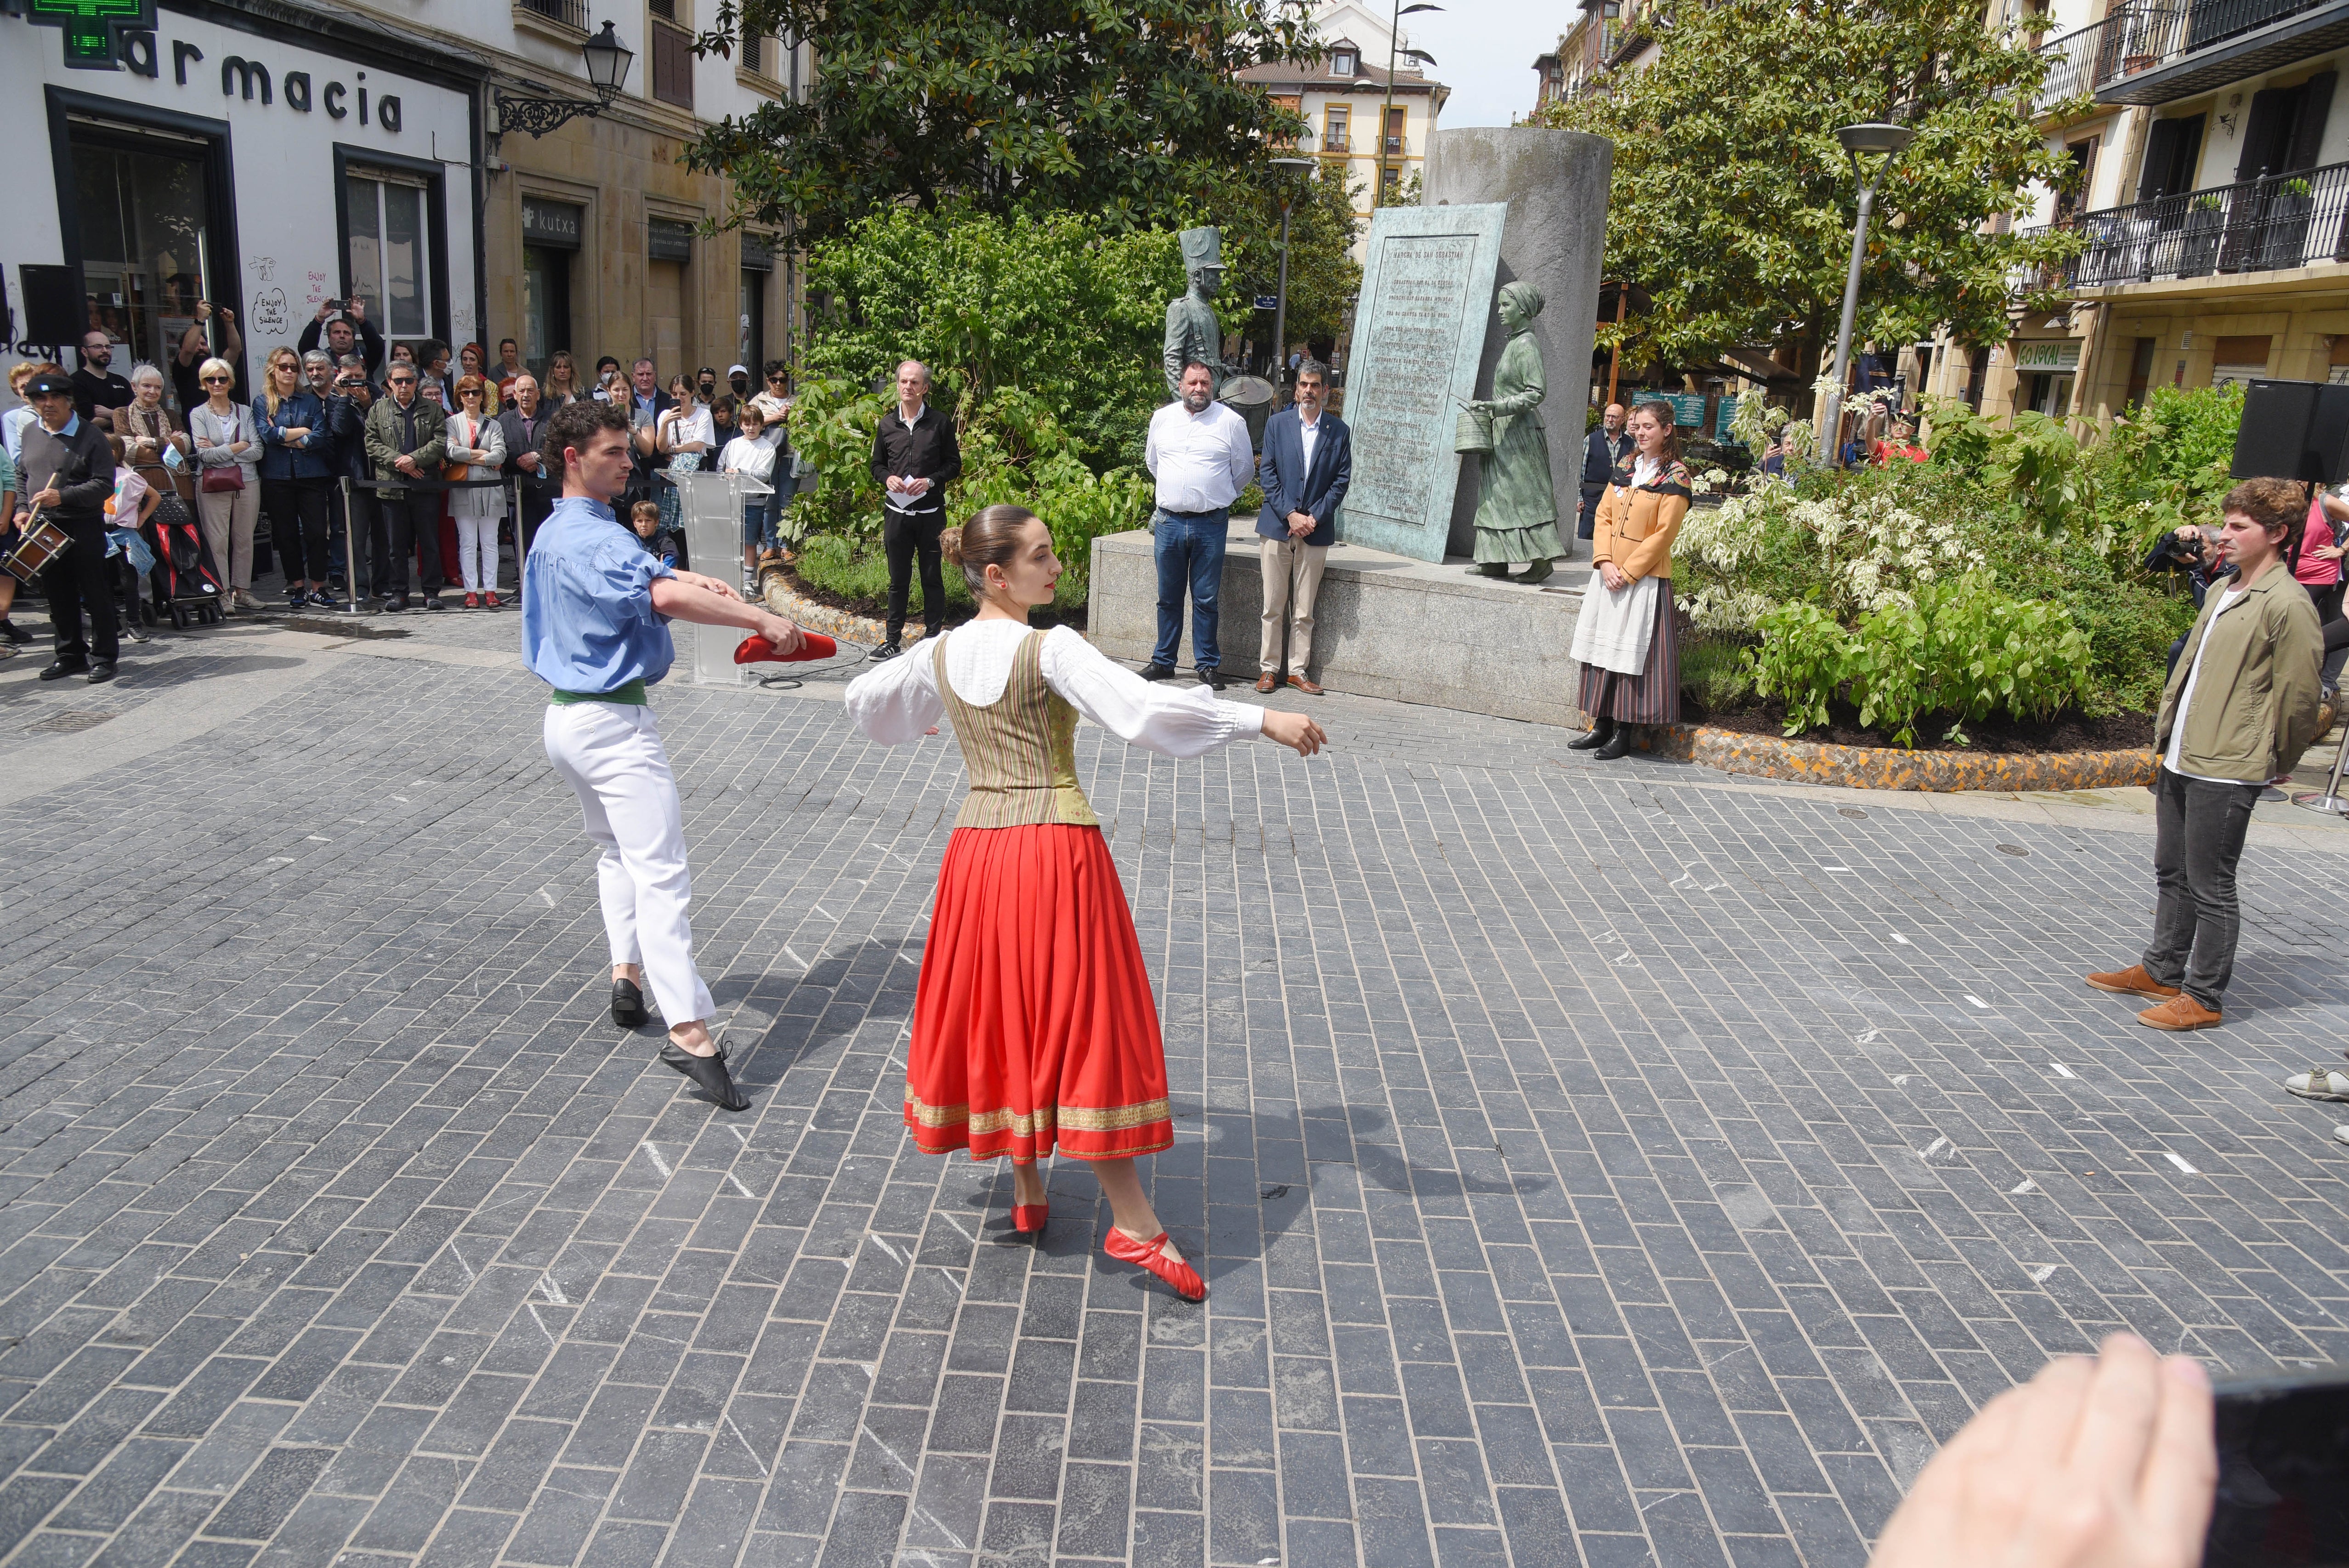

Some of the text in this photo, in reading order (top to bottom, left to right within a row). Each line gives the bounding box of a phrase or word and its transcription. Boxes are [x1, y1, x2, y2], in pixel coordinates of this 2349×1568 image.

[125, 30, 402, 132] armacia
[539, 210, 575, 234] kutxa
[308, 272, 326, 283] ENJOY
[312, 284, 321, 293] THE
[2019, 344, 2060, 365] GO LOCAL
